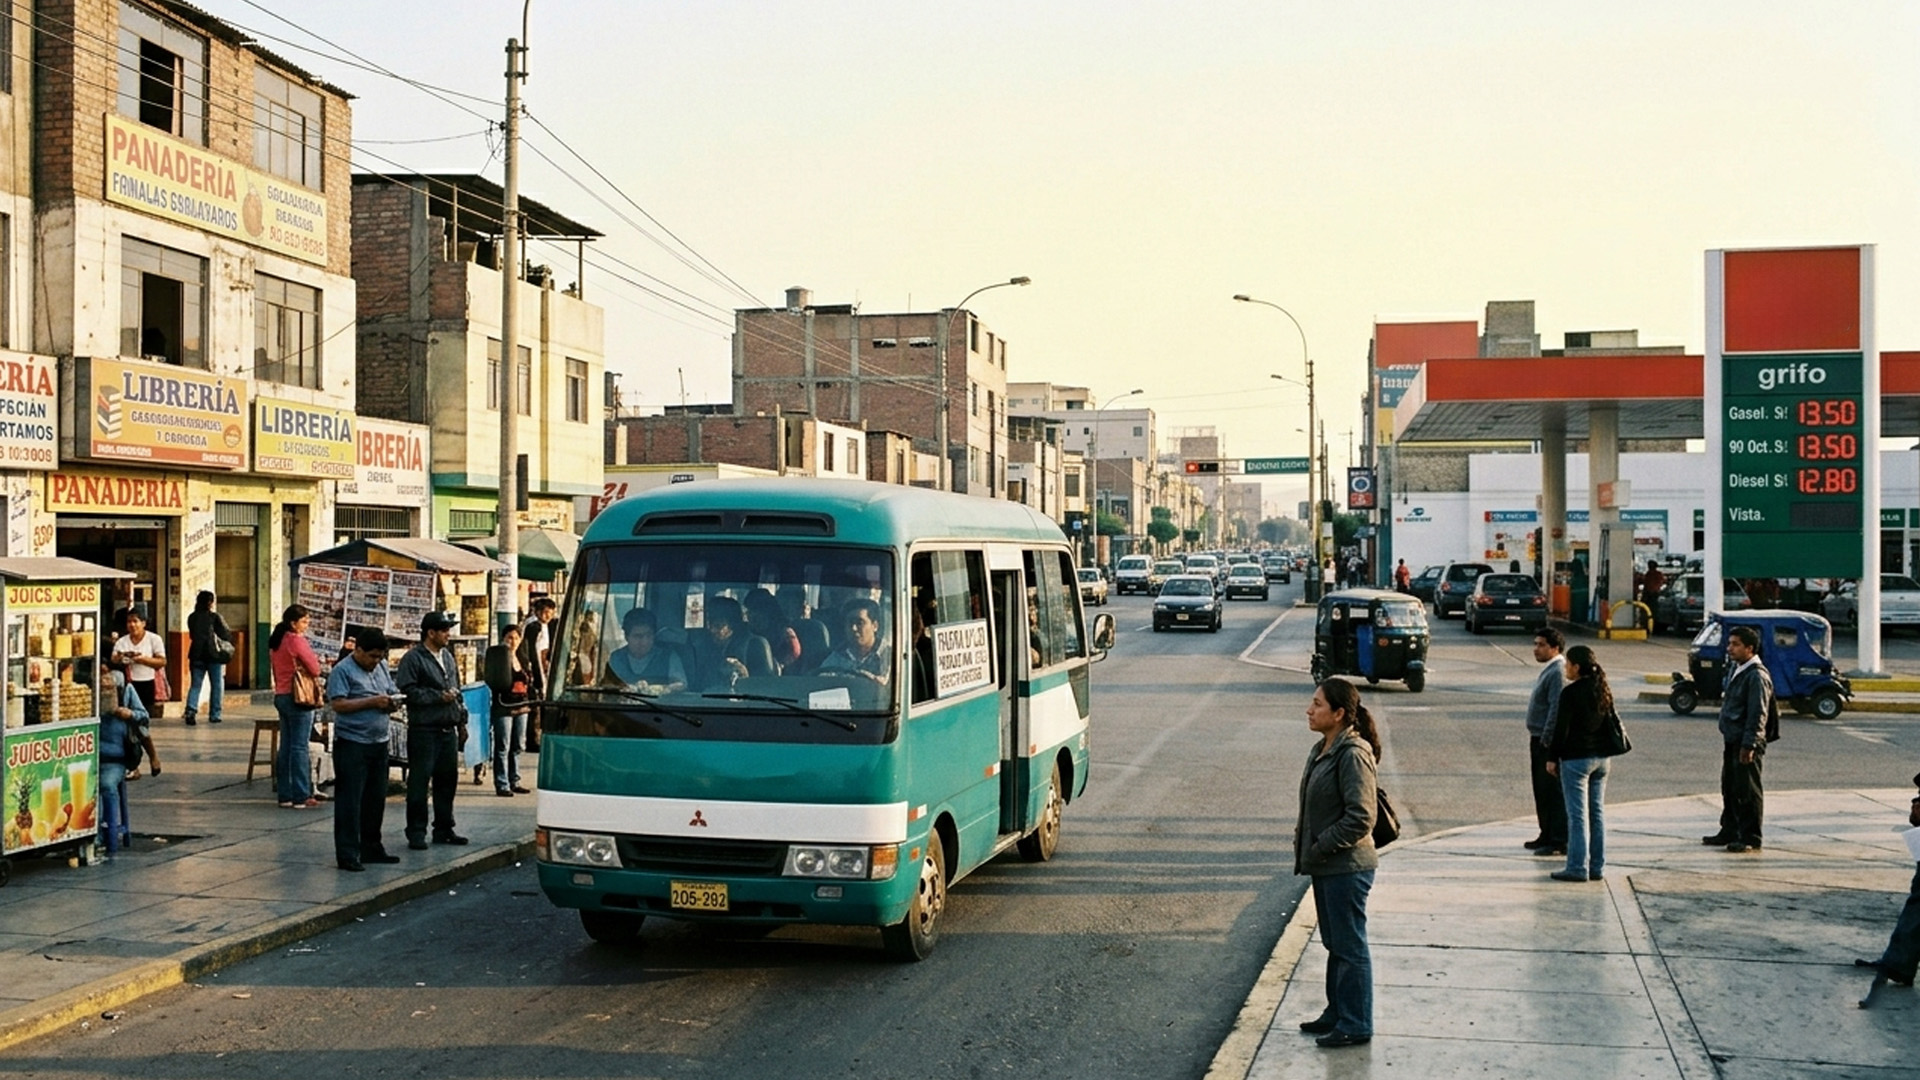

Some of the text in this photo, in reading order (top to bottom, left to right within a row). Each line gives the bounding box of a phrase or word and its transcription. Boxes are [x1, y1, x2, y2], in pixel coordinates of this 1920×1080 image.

[1758, 363, 1826, 390] grifo
[123, 372, 240, 415] LIBRERÍA
[261, 405, 352, 443] LIBRERÍA
[1799, 401, 1856, 426] 13.50
[1747, 440, 1773, 453] Oct.
[1799, 434, 1856, 459] 13.50
[1729, 474, 1769, 487] Diesel
[1729, 508, 1766, 521] Vista.
